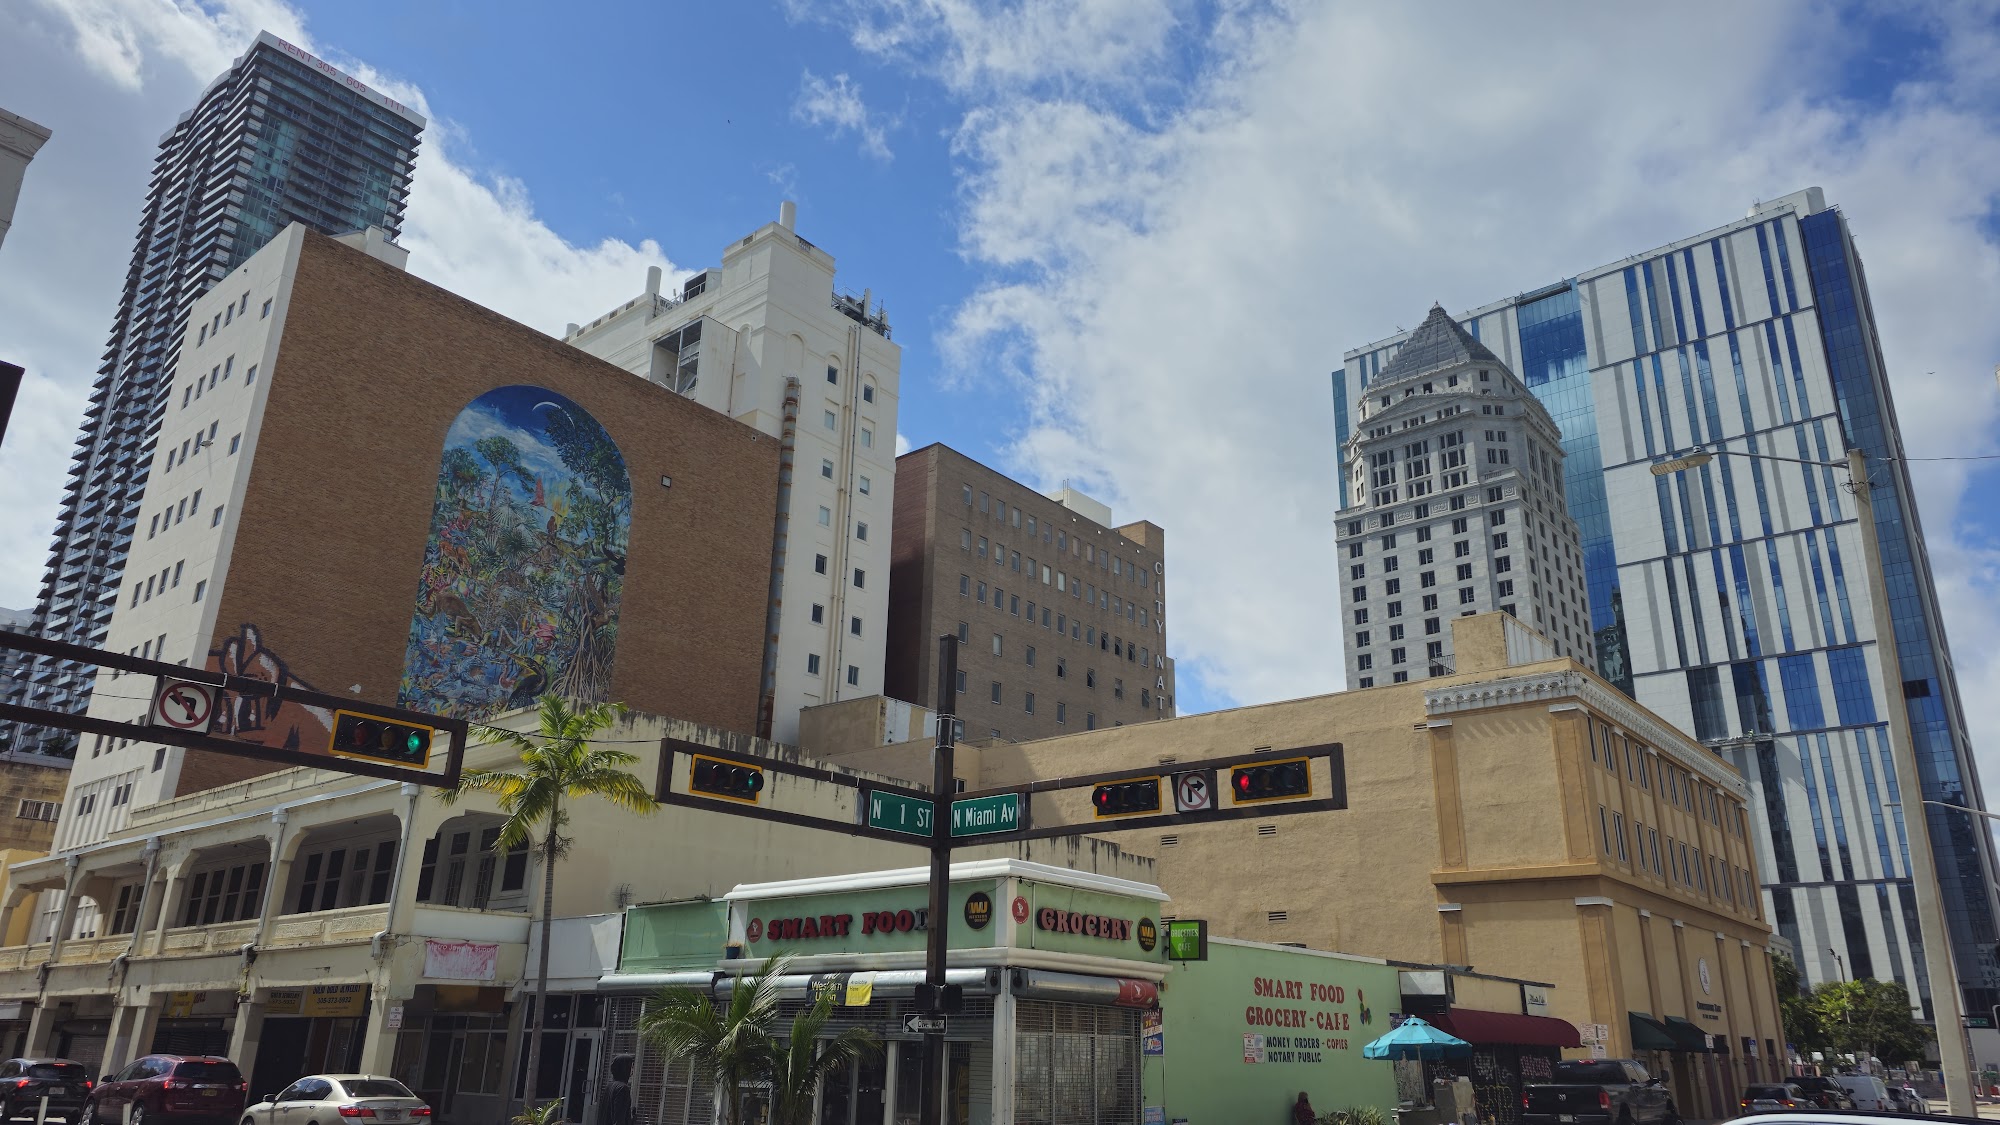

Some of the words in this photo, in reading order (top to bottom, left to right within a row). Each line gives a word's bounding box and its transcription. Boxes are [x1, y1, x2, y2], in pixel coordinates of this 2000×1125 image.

[278, 38, 313, 63] RENT
[316, 59, 336, 77] 305
[346, 76, 366, 93] 605
[1155, 561, 1163, 634] CITY
[1156, 654, 1165, 720] NAT
[873, 799, 882, 820] N
[900, 803, 906, 825] 1
[917, 807, 931, 828] ST
[954, 809, 961, 829] N
[965, 805, 996, 827] Miami
[1001, 803, 1015, 823] Av
[767, 914, 852, 940] SMART
[1038, 908, 1134, 941] GROCERY
[1170, 928, 1199, 938] GROCERIES
[428, 942, 448, 951] Metro
[1177, 943, 1191, 951] CAFE
[815, 991, 837, 1001] Uon
[1254, 976, 1303, 1000] SMART
[1310, 983, 1345, 1004] FOOD
[1245, 1006, 1307, 1028] GROCERY
[1266, 1036, 1291, 1048] MONEY
[1294, 1037, 1320, 1049] ORDERS
[1326, 1038, 1348, 1050] COPIES
[1268, 1051, 1295, 1063] NOTARY
[1298, 1052, 1322, 1063] PUBLIC
